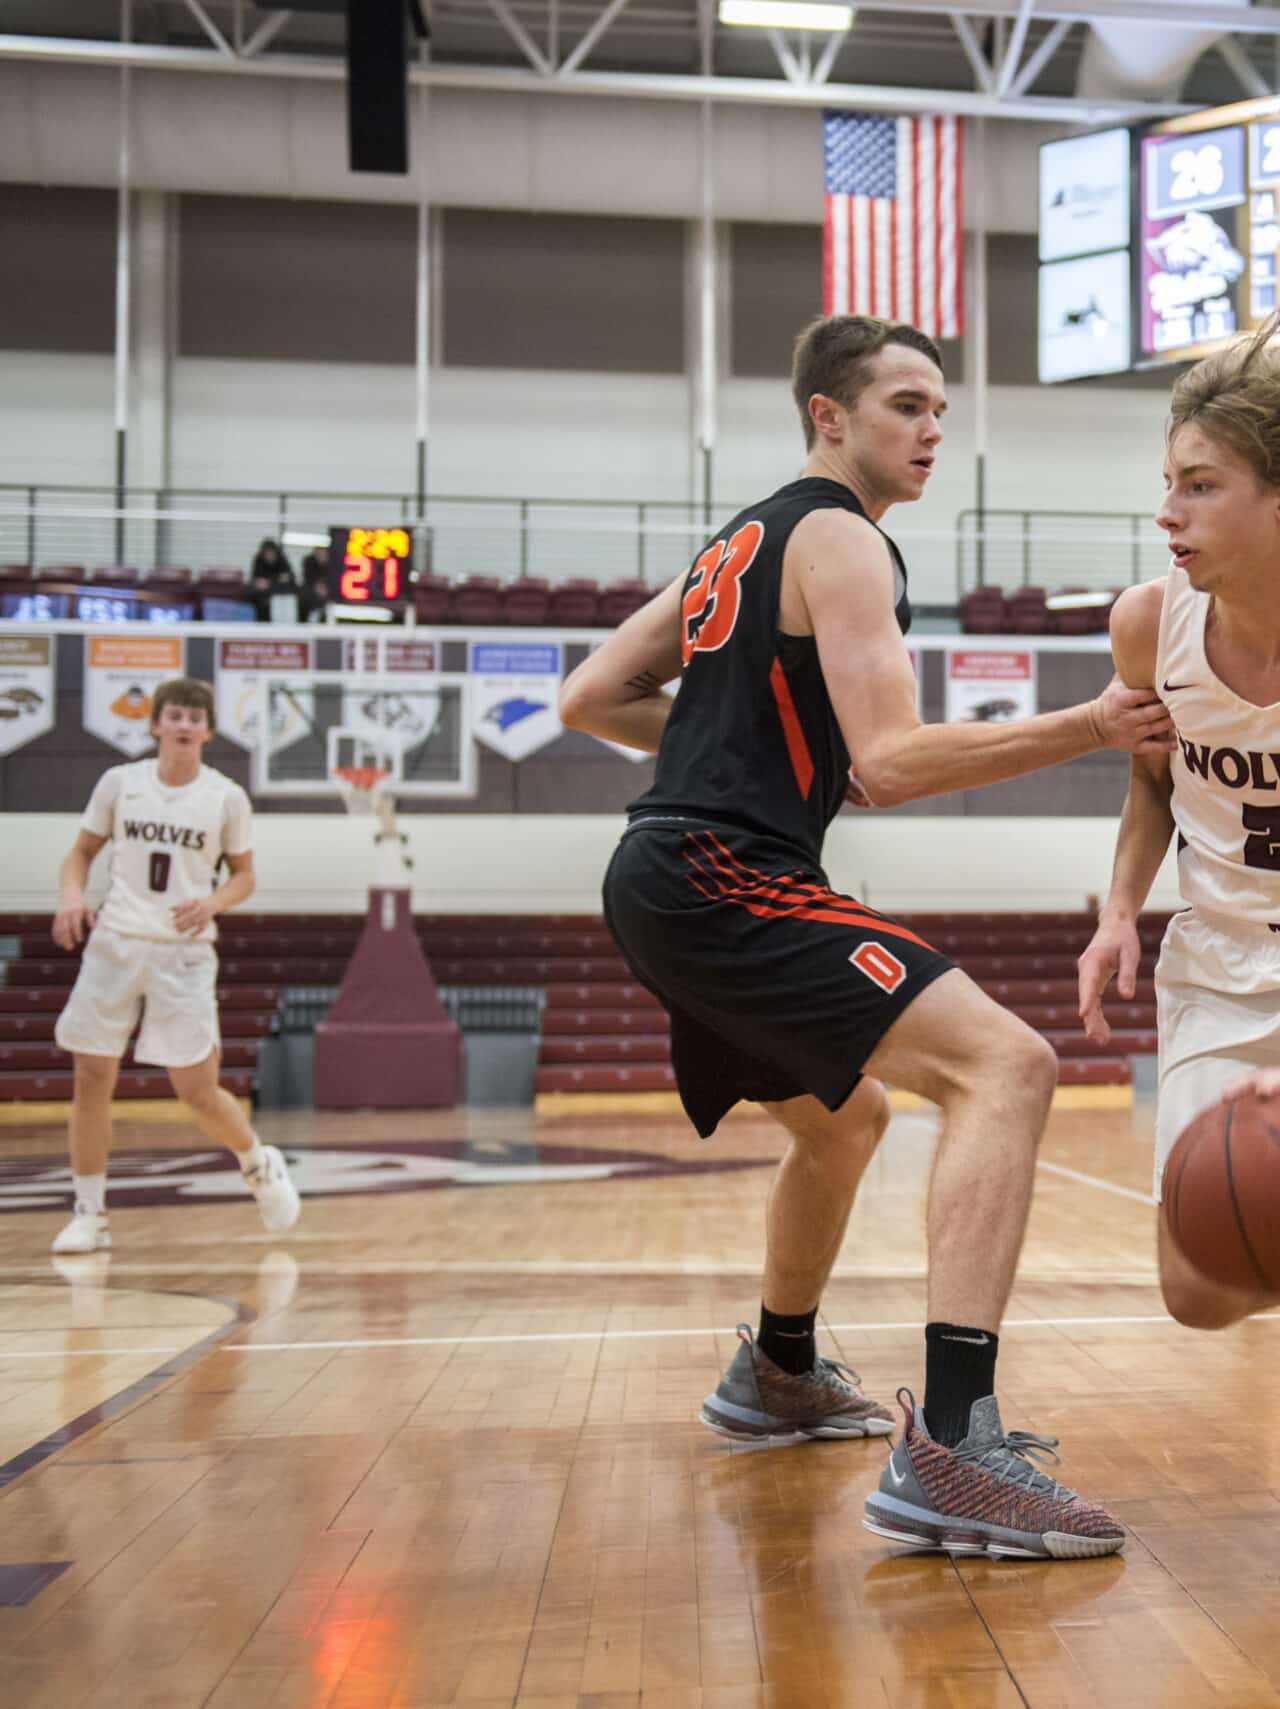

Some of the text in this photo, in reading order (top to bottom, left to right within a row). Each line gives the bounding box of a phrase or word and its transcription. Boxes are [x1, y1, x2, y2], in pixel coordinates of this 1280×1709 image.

[340, 555, 400, 601] 21
[124, 819, 206, 850] WOLVES
[149, 851, 171, 893] 0
